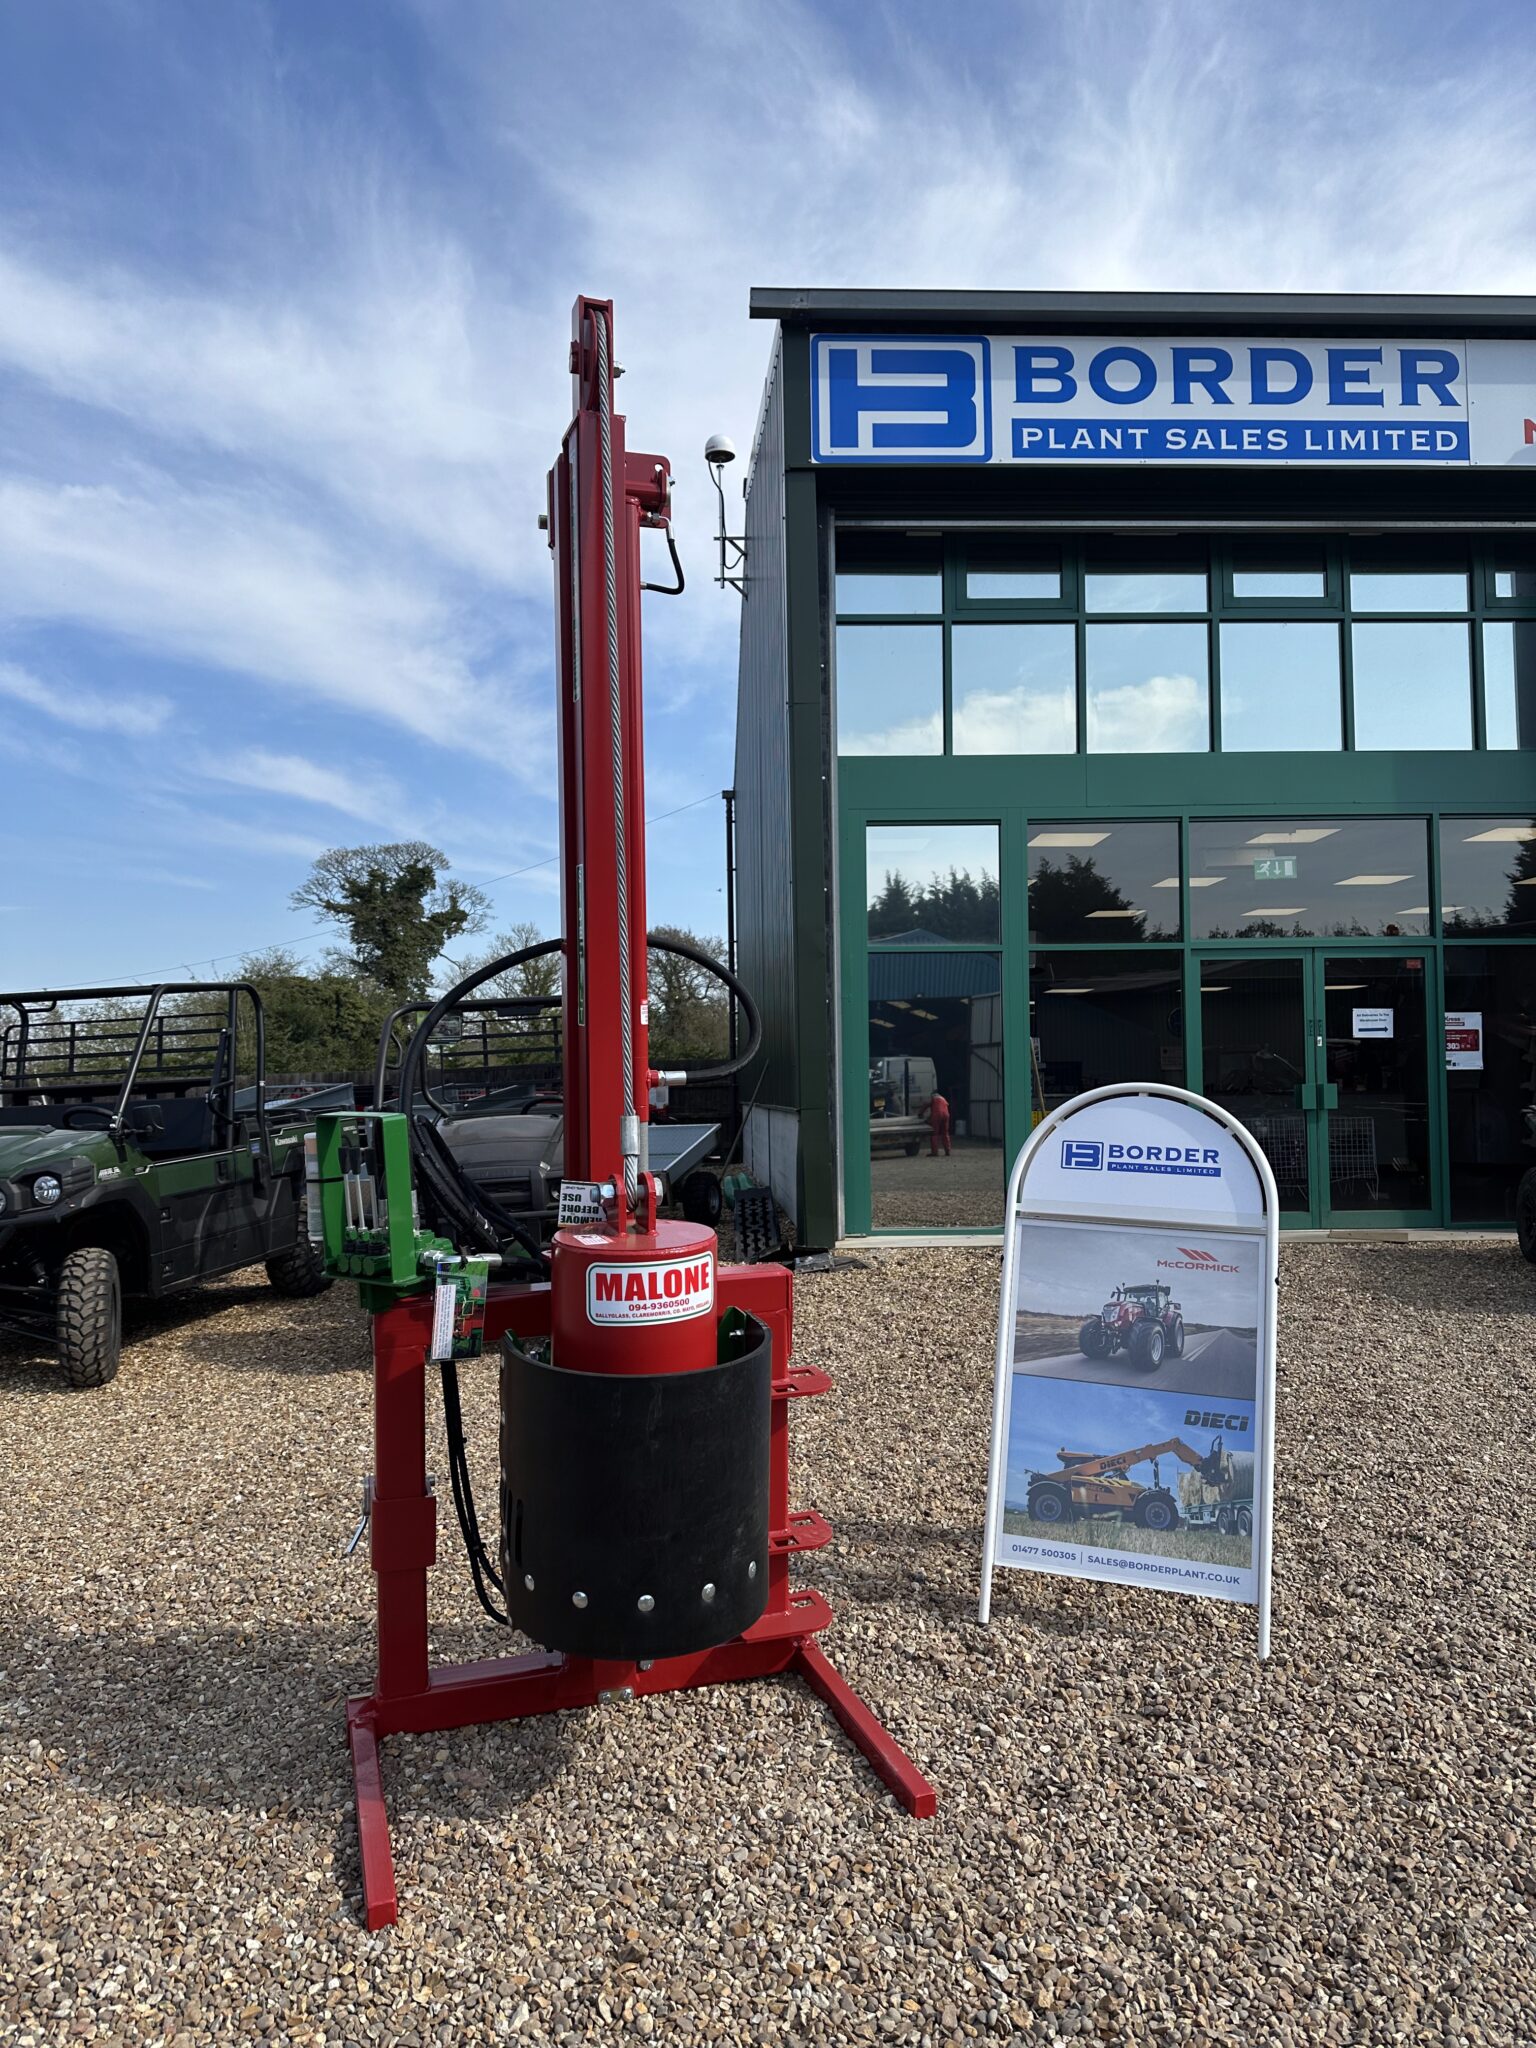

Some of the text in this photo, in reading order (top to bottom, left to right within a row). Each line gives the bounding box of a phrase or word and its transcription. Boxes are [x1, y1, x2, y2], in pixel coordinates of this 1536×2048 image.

[1012, 345, 1462, 409] BORDER
[1021, 427, 1459, 452] PLANT SALES LIMITED
[1108, 1144, 1220, 1164] BORDER
[1111, 1163, 1216, 1175] PLANT SALES LIMITED
[561, 1192, 582, 1202] USE
[560, 1203, 600, 1215] BEFORE
[1156, 1259, 1240, 1273] McCORMICK
[595, 1261, 710, 1302] MALONE
[628, 1297, 690, 1312] 094-9360500
[1183, 1409, 1249, 1432] DIECI
[1011, 1543, 1241, 1585] 01477 500305 SALES@BORDERPLANT.CO.UK
